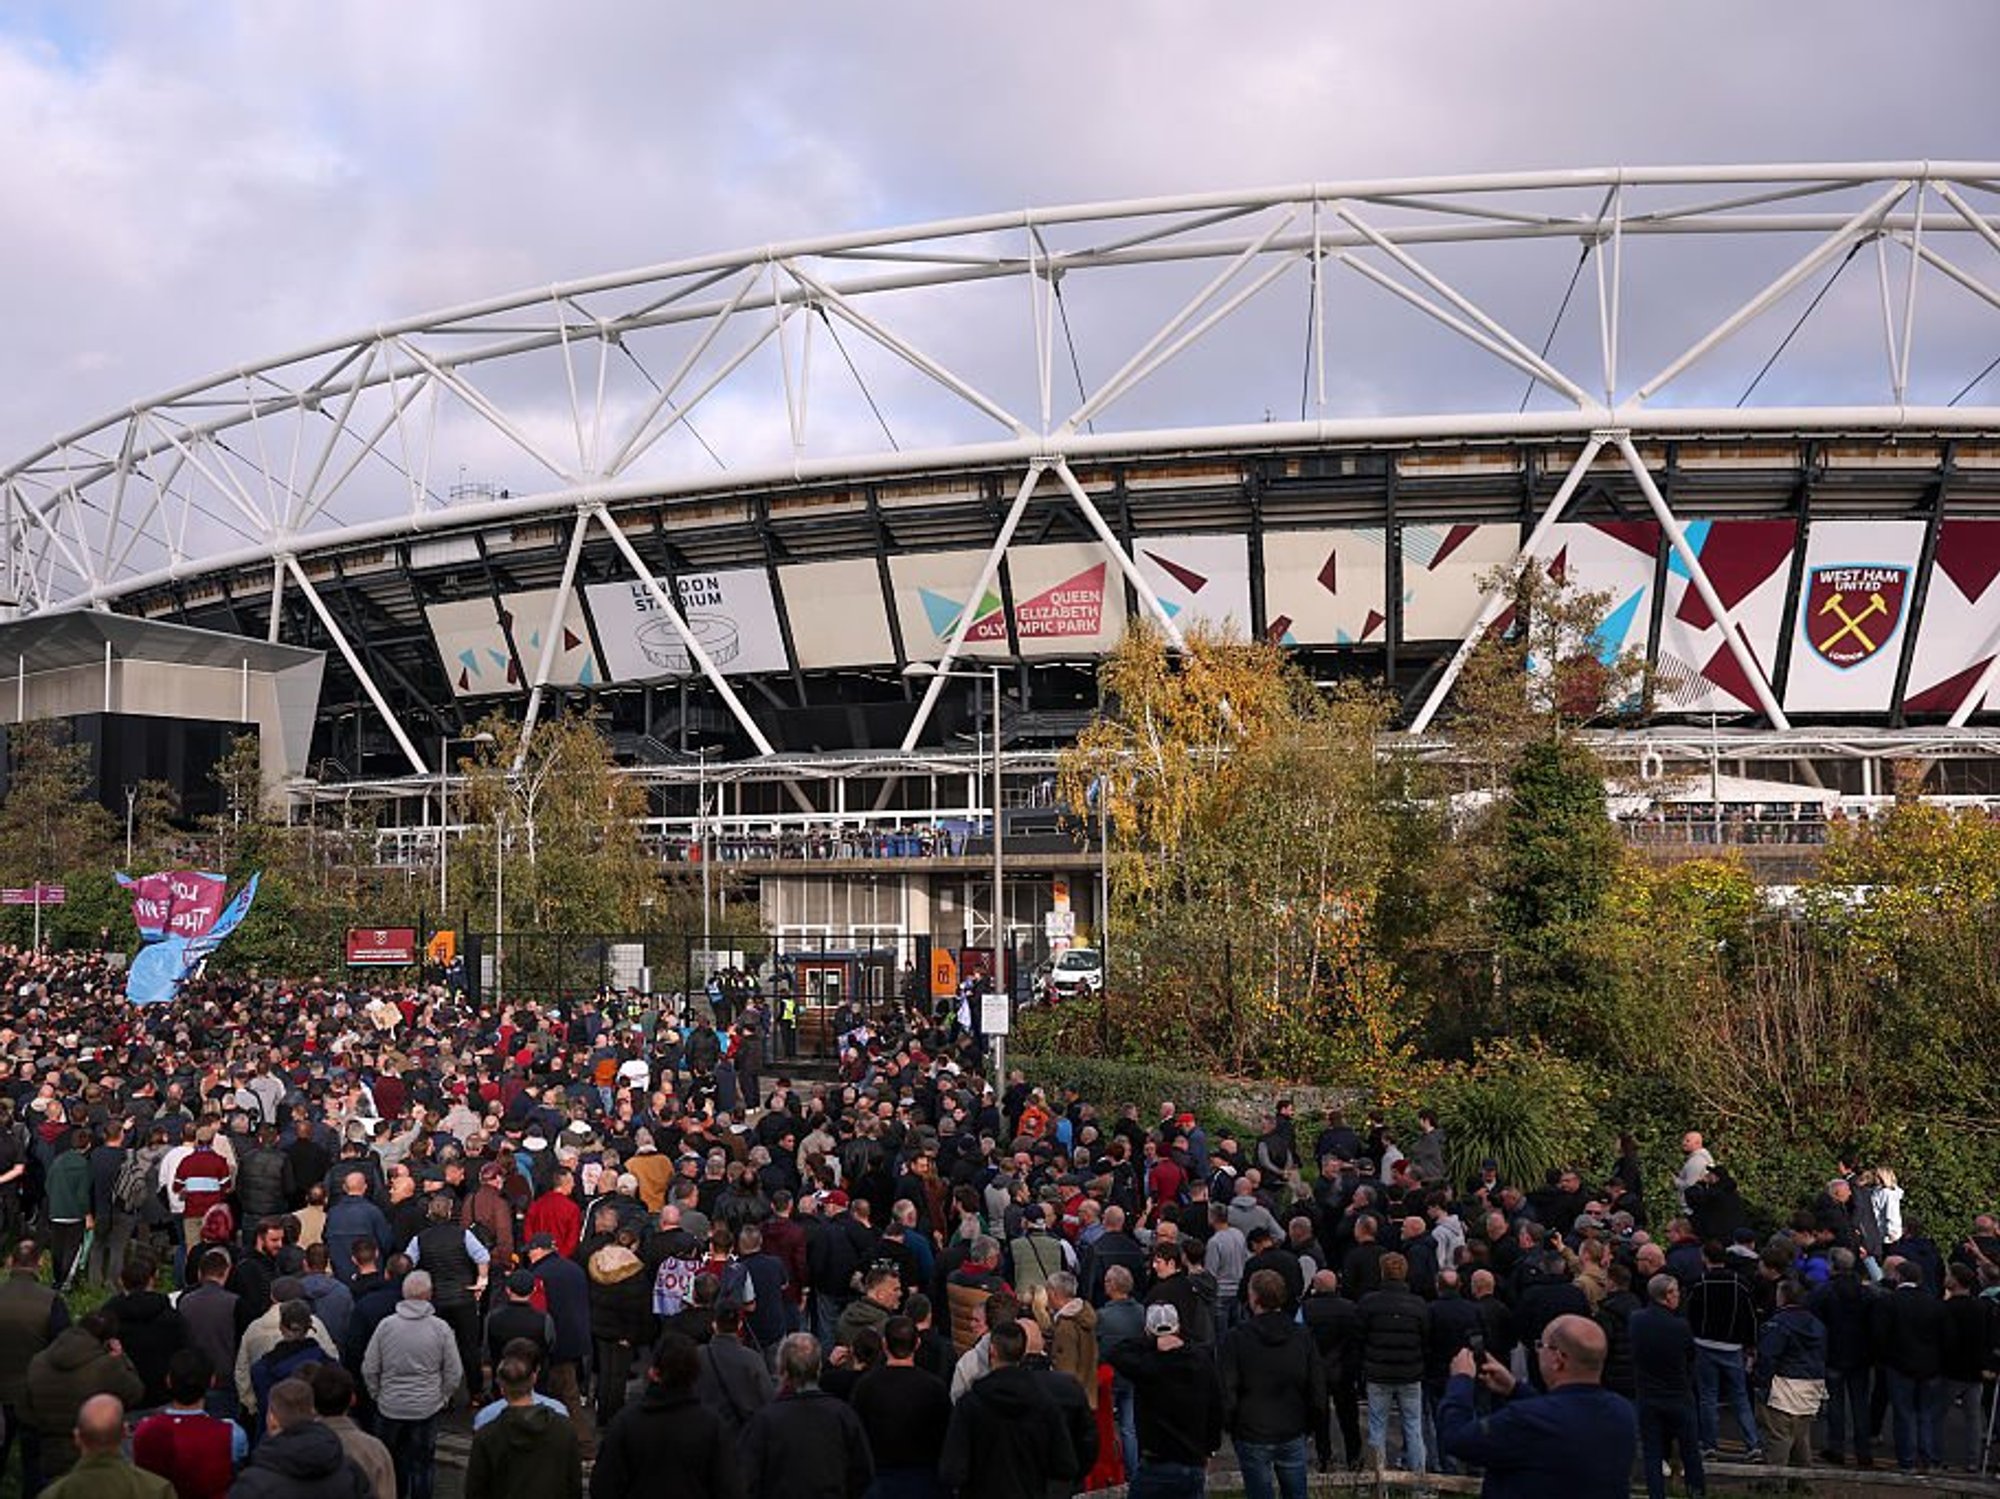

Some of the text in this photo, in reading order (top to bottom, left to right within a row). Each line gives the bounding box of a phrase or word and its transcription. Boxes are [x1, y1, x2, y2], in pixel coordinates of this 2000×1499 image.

[1820, 569, 1899, 583] WEST HAM
[1835, 582, 1881, 591] UNITED
[1050, 589, 1100, 606] QUEEN
[1020, 605, 1099, 620] ELIZABETH
[1057, 618, 1097, 633] PARK
